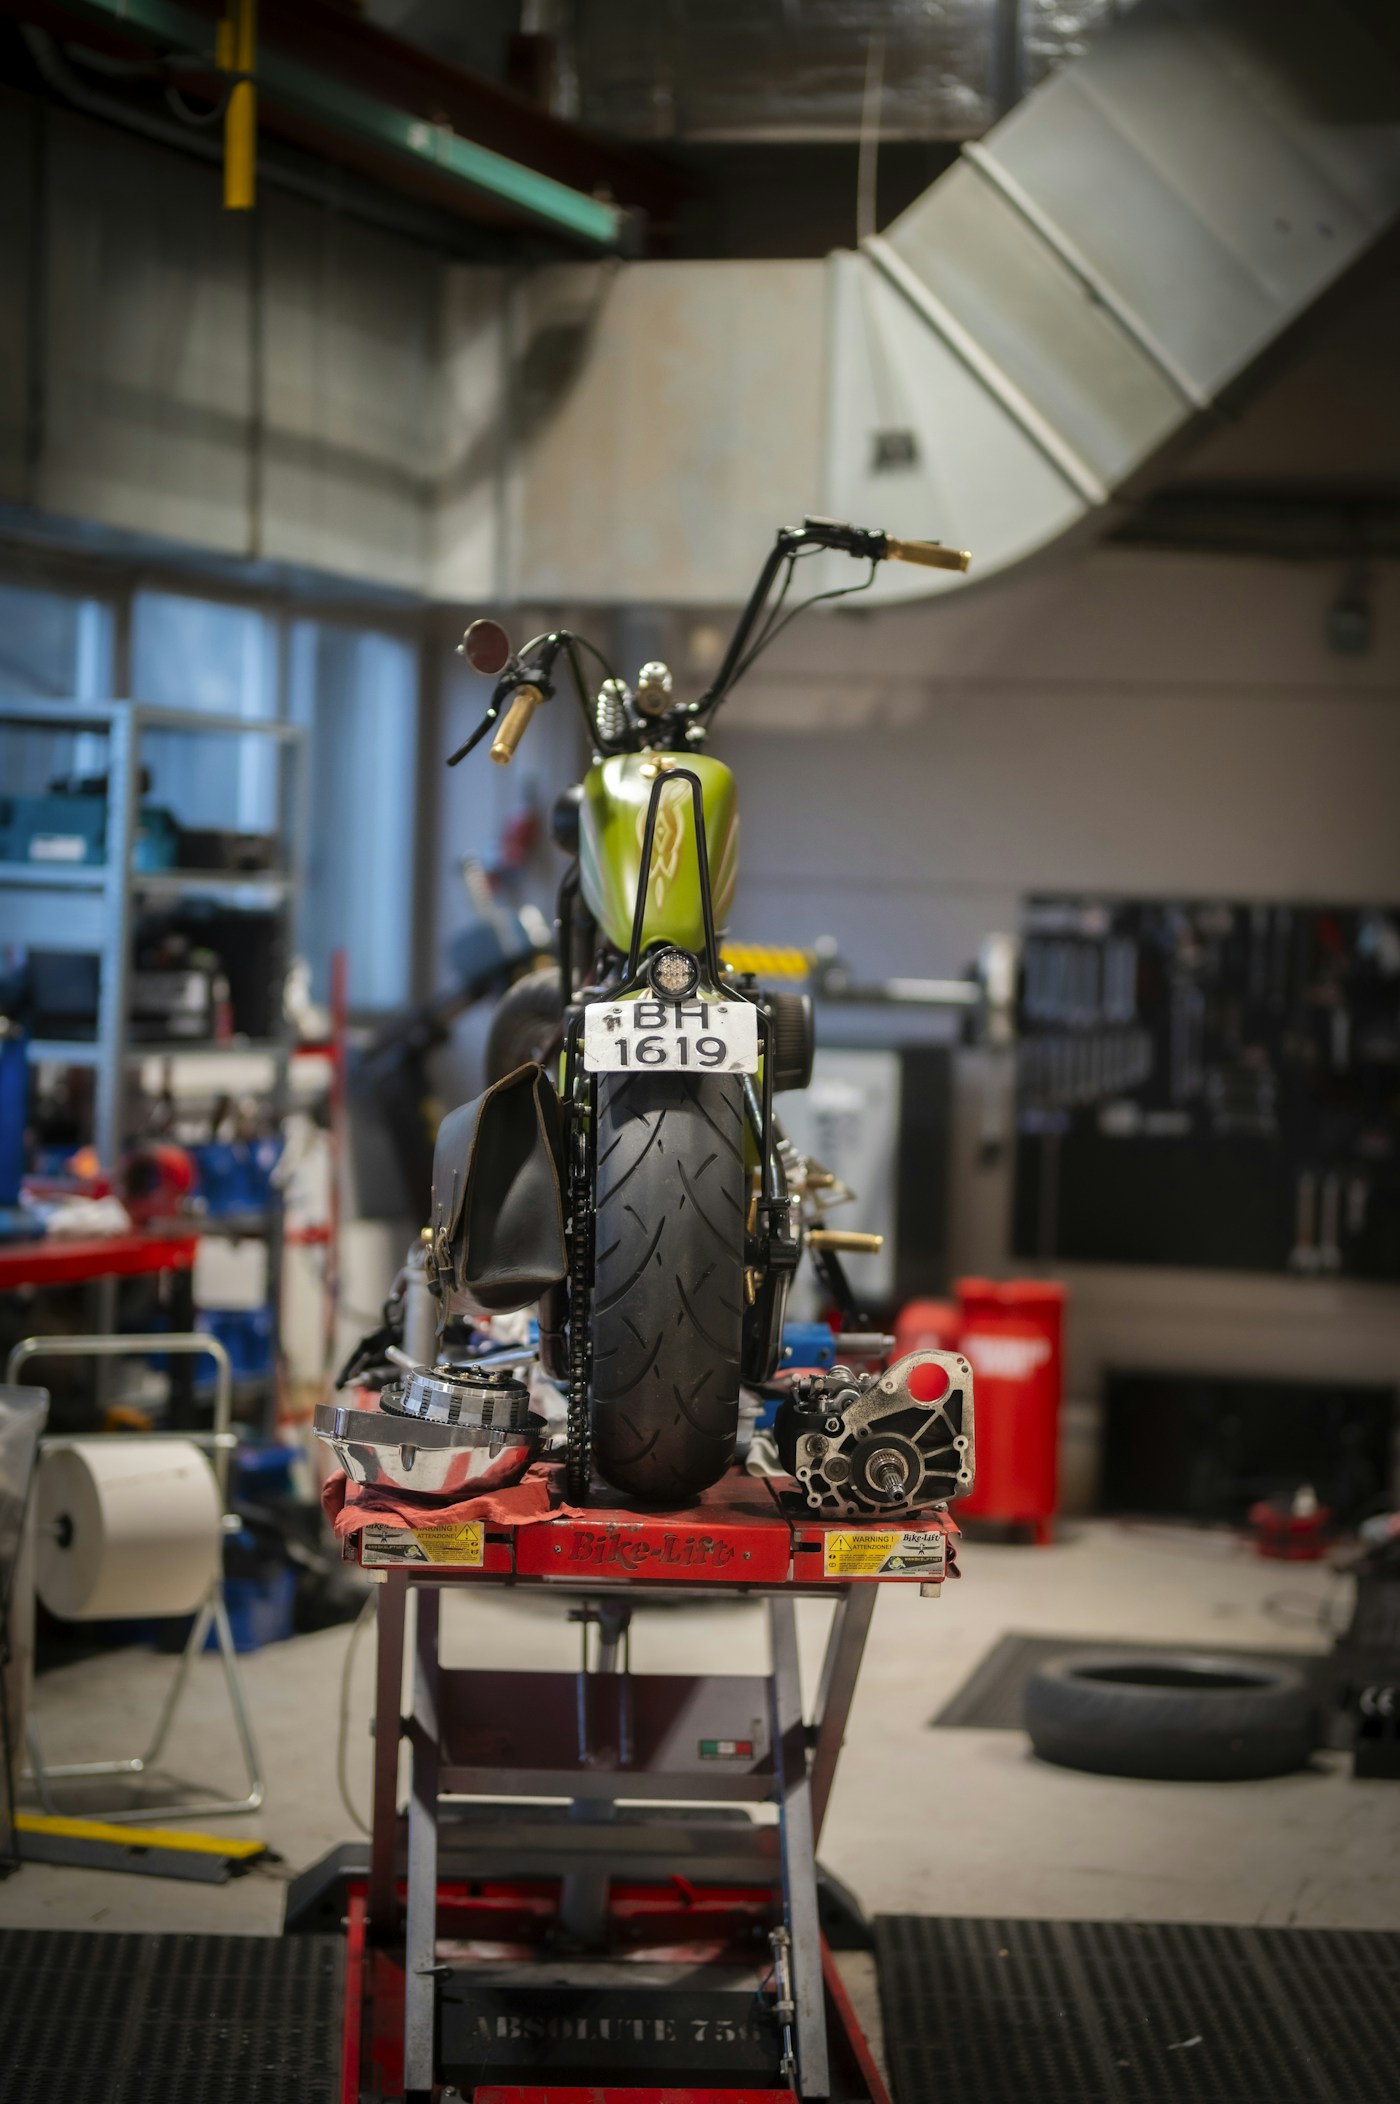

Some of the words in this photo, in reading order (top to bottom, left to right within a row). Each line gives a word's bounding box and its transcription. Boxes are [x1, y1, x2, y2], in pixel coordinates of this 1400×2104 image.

[632, 1002, 710, 1030] BH
[614, 1035, 727, 1067] 1619
[567, 1531, 735, 1571] Bike-Lift
[852, 1535, 890, 1543] WARNING
[902, 1533, 941, 1543] Bike-Lift
[472, 2015, 677, 2042] ABSOLUTE
